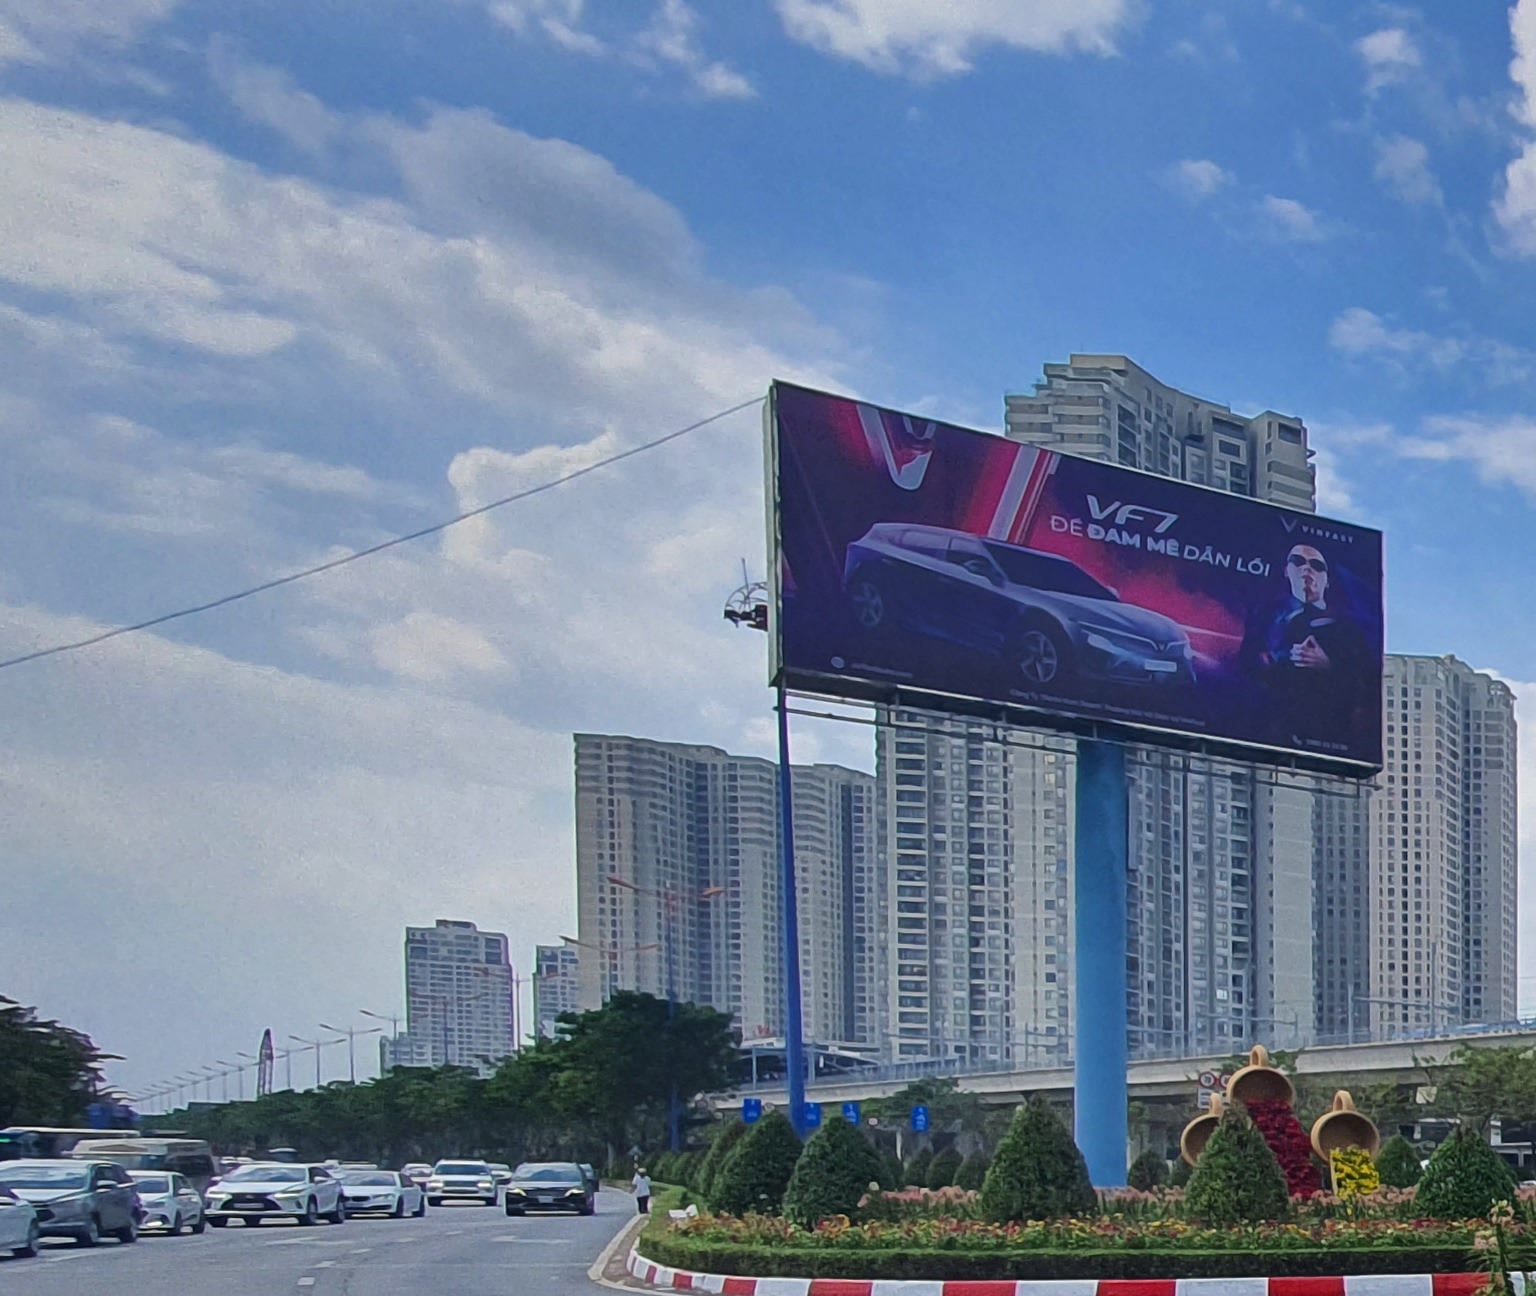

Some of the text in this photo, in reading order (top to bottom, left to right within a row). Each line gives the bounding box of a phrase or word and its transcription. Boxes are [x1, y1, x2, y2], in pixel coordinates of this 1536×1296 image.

[1086, 494, 1180, 534] VF7
[1087, 523, 1141, 549] ĐAM
[1147, 536, 1180, 557] MÊ
